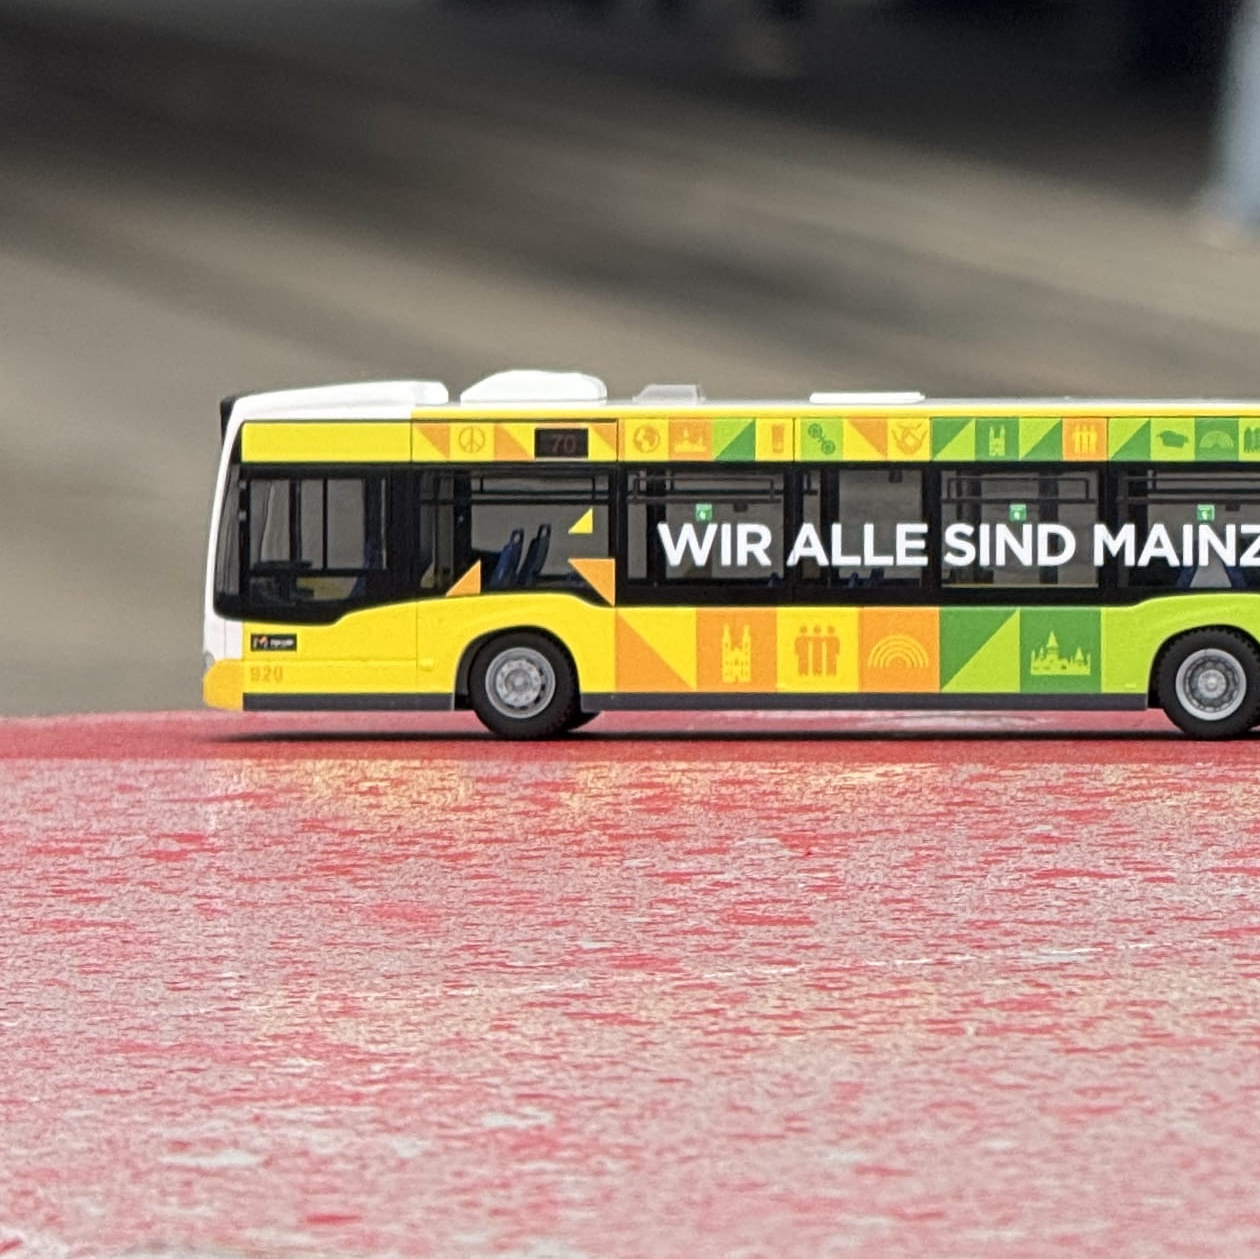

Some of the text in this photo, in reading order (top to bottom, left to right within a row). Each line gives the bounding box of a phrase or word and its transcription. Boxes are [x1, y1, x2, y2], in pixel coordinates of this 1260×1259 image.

[551, 433, 577, 454] 70
[658, 523, 772, 567] WIR
[786, 523, 929, 567] ALLE
[943, 522, 1077, 567] SIND
